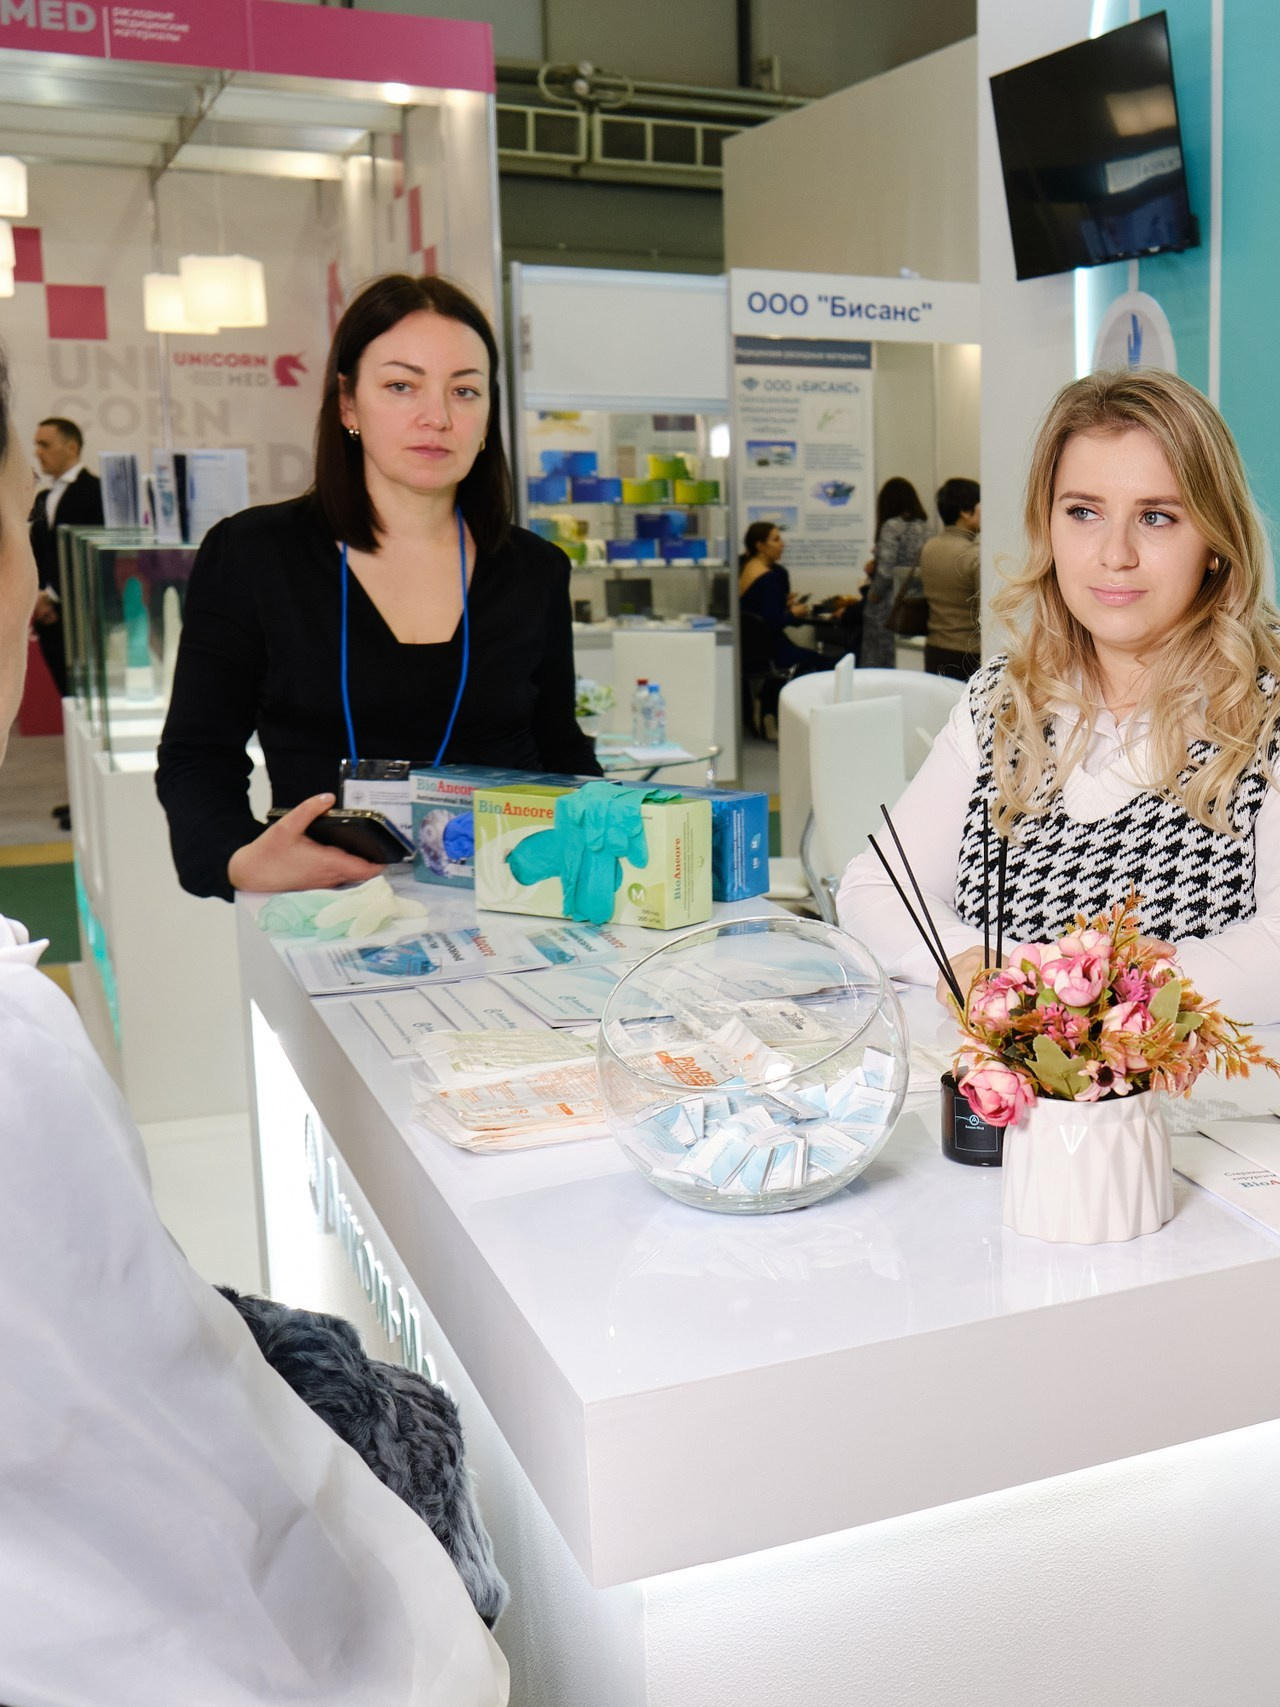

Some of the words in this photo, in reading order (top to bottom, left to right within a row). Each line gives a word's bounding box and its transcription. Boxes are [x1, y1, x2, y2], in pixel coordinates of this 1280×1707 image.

[1, 0, 96, 32] MED
[747, 291, 809, 317] ООО
[817, 294, 933, 322] "Бисанс"
[173, 352, 268, 368] UNICORN
[416, 778, 479, 795] BioAncor
[478, 800, 554, 818] BioAncore
[632, 888, 645, 902] M
